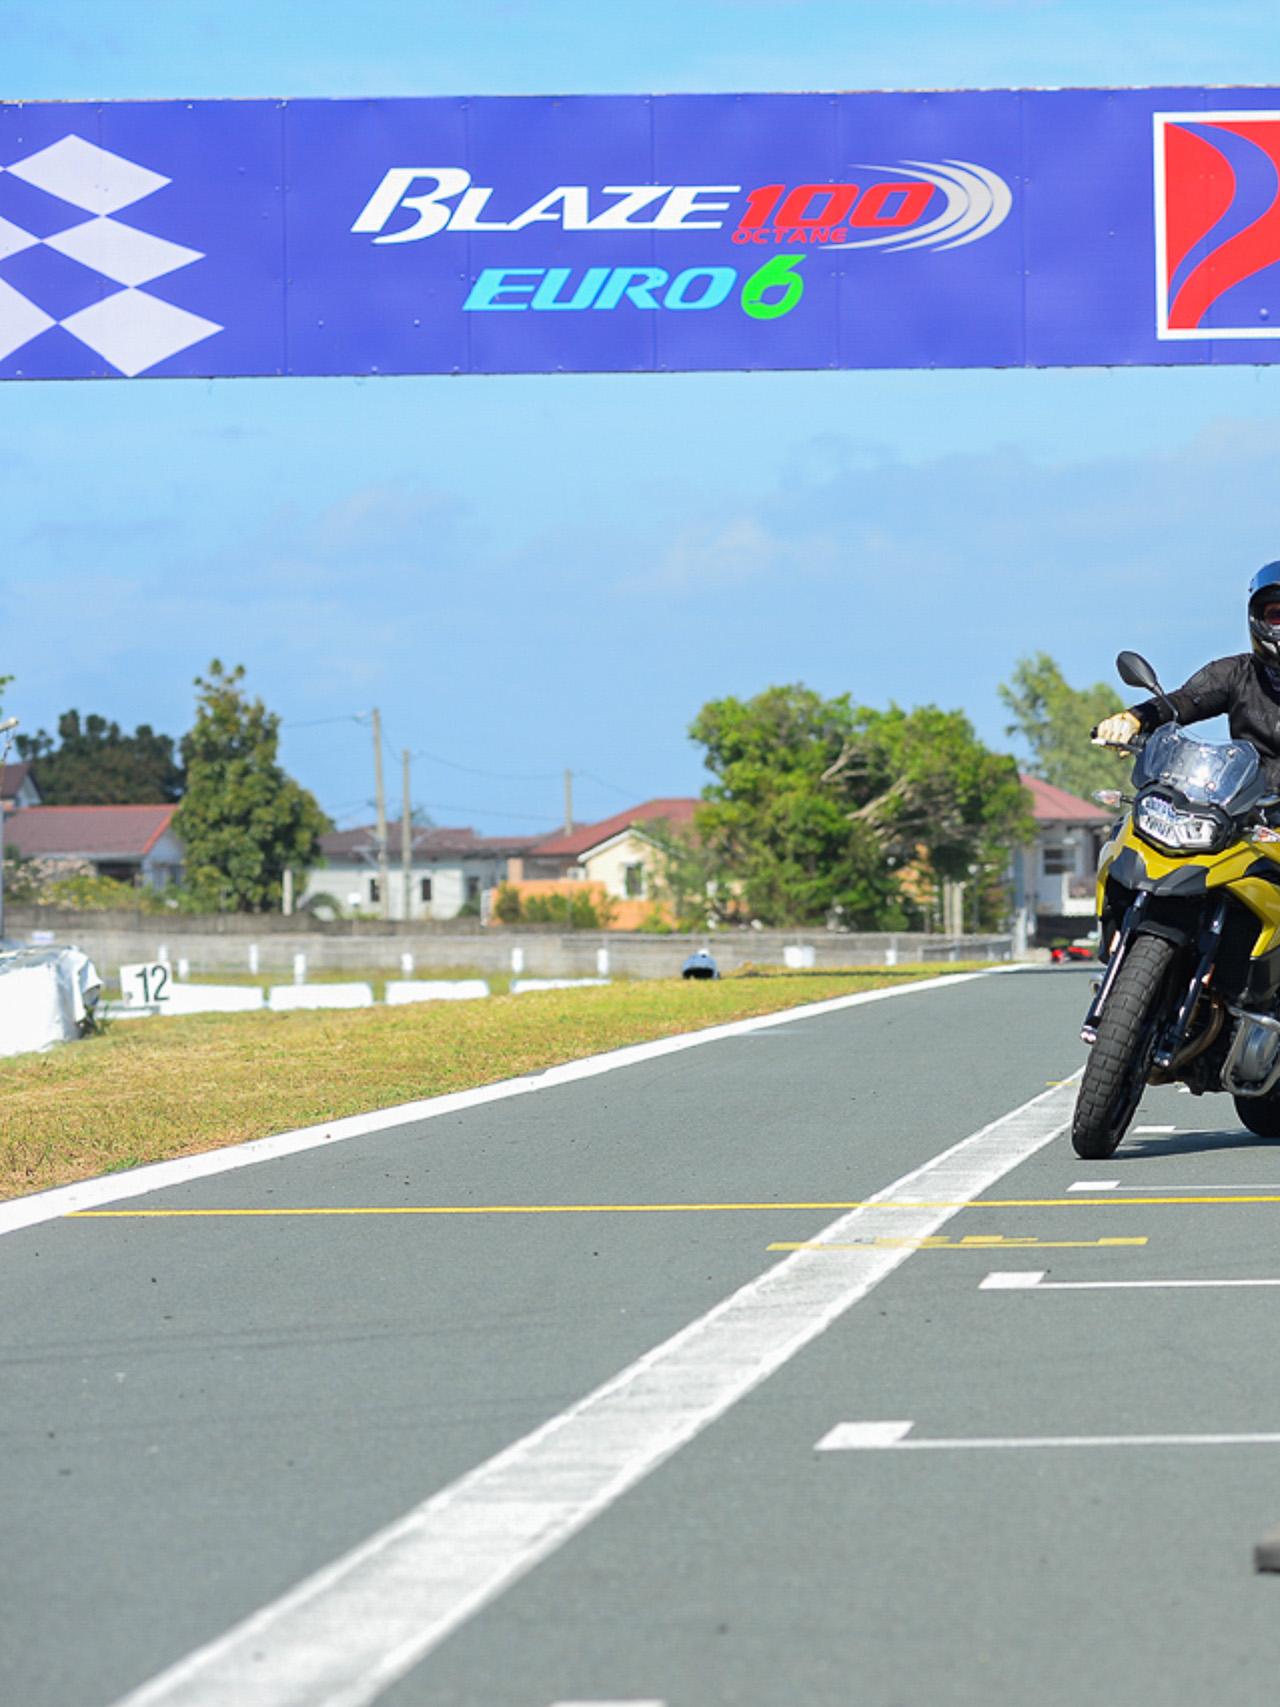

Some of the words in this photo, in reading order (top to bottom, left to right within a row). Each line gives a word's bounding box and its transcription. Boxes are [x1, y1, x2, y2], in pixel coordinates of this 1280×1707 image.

[350, 168, 741, 244] BLAZE
[737, 182, 936, 230] 100
[731, 227, 848, 244] OCTANE
[462, 267, 738, 311] EURO
[741, 254, 807, 320] 6
[135, 965, 170, 1003] 12
